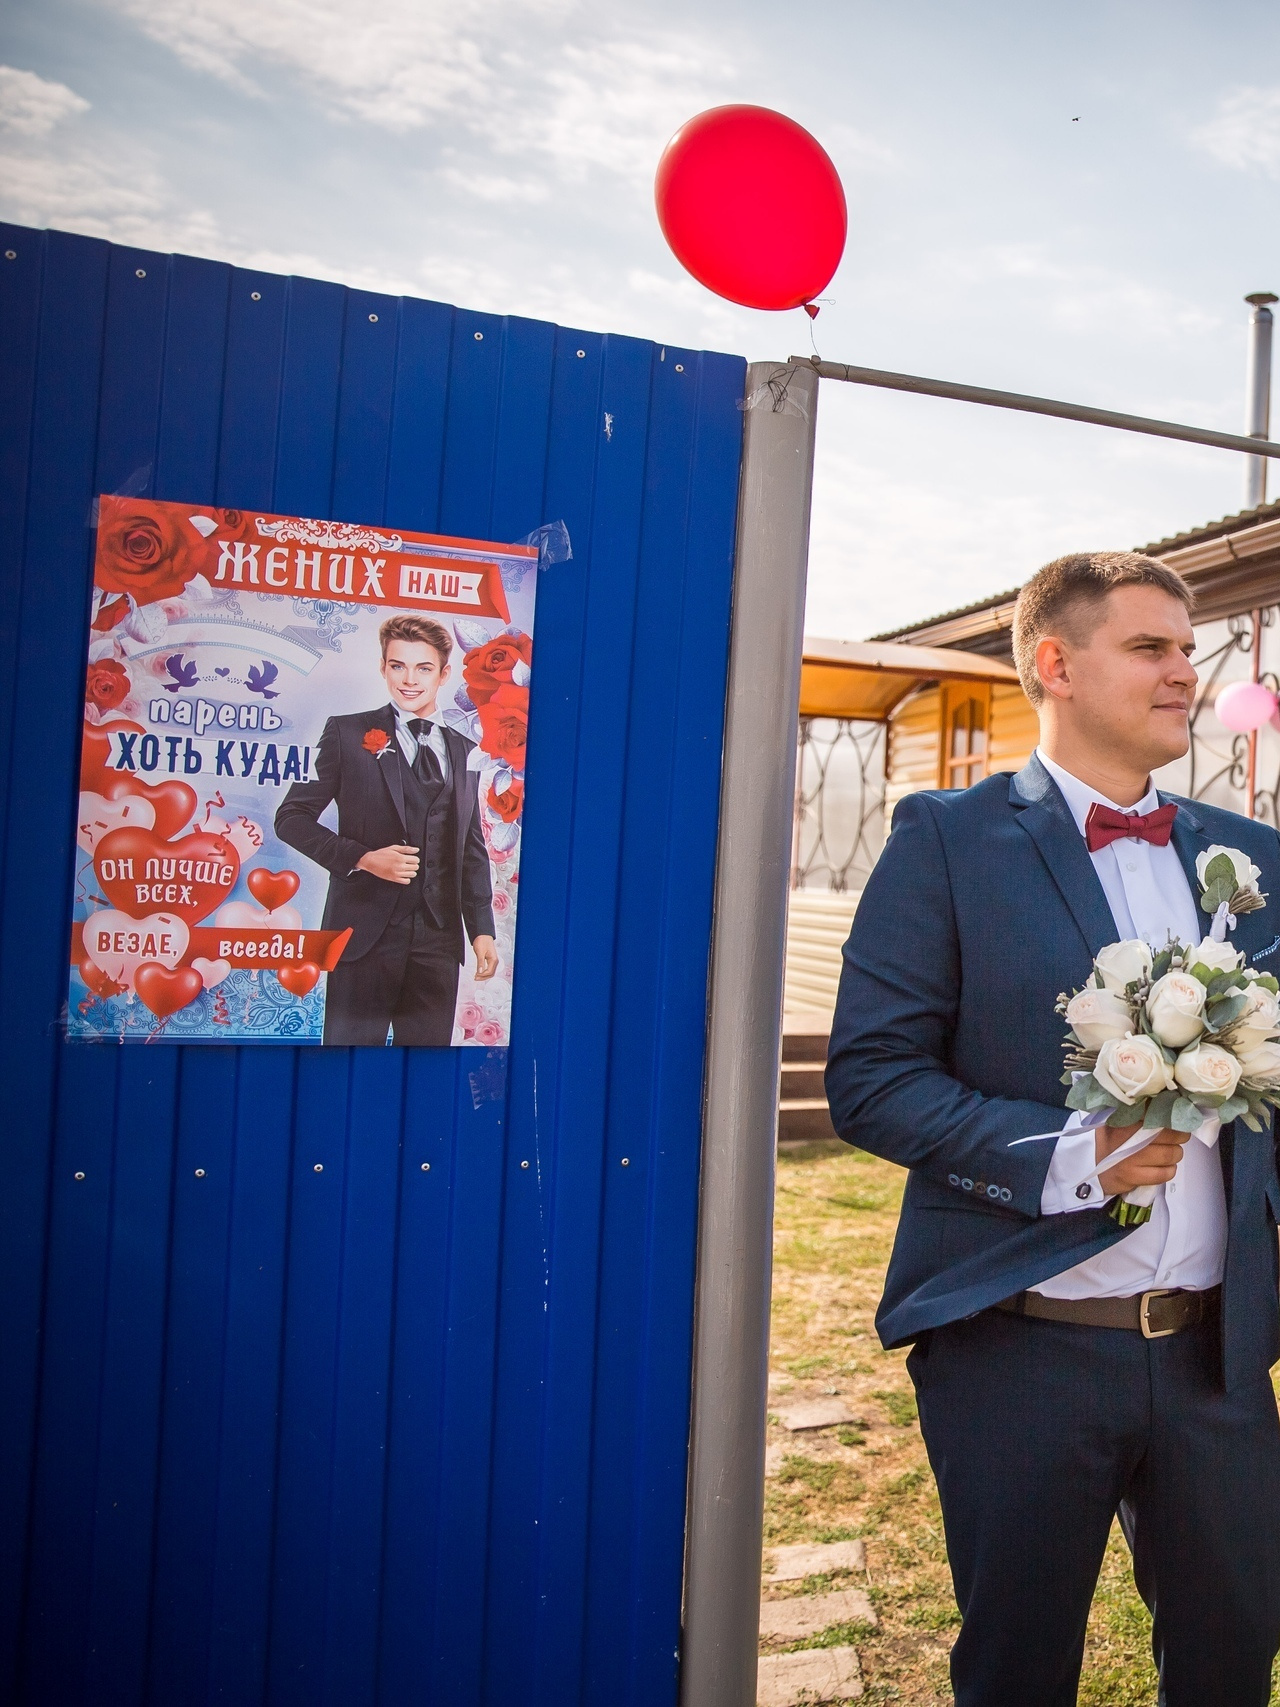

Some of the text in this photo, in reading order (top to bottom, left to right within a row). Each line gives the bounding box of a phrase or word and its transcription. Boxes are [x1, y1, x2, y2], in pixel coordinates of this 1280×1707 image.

[214, 540, 388, 599] ЖЕНИХ
[148, 698, 283, 736] парень
[115, 732, 312, 785] ХОТЬ КУДА!
[100, 857, 235, 887] ОН ЛУЧШЕ
[135, 883, 199, 908] ВСЕХ,
[97, 930, 305, 960] ВЕЗДЕ, всегда!
